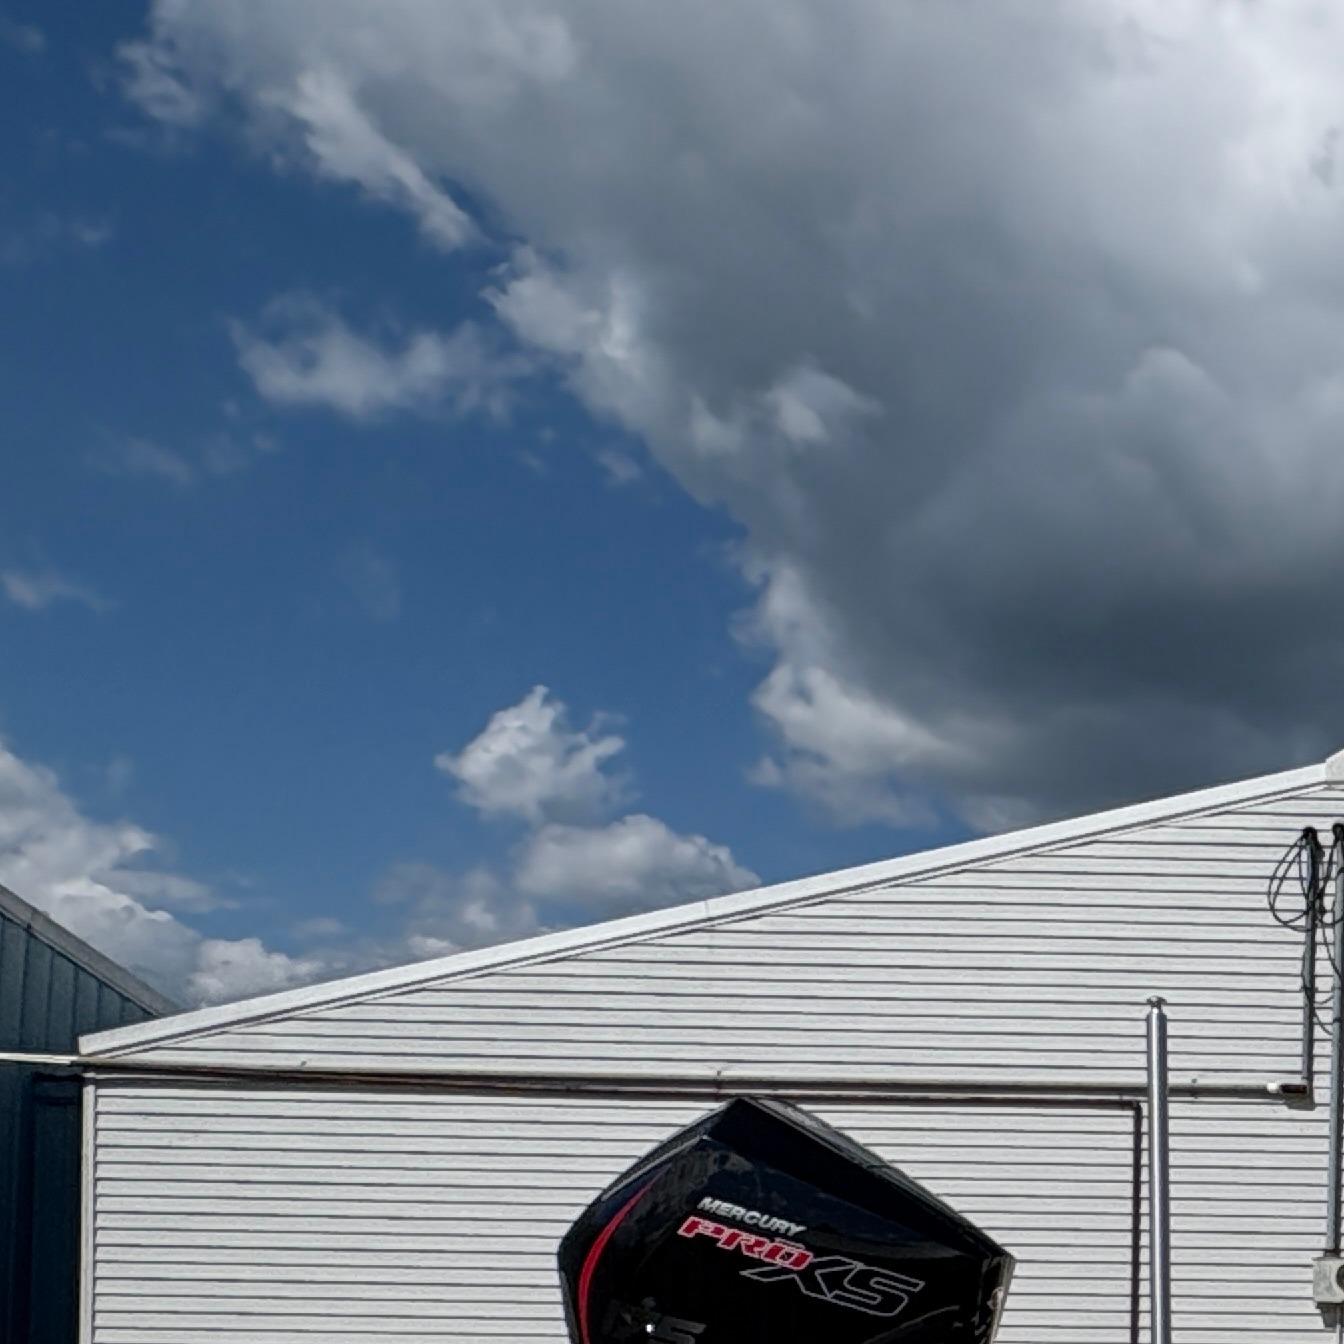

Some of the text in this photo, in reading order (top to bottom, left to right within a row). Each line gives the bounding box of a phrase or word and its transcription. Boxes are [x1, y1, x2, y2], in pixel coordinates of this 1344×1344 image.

[697, 1196, 807, 1236] MERCURY
[677, 1216, 925, 1317] PRO XS
